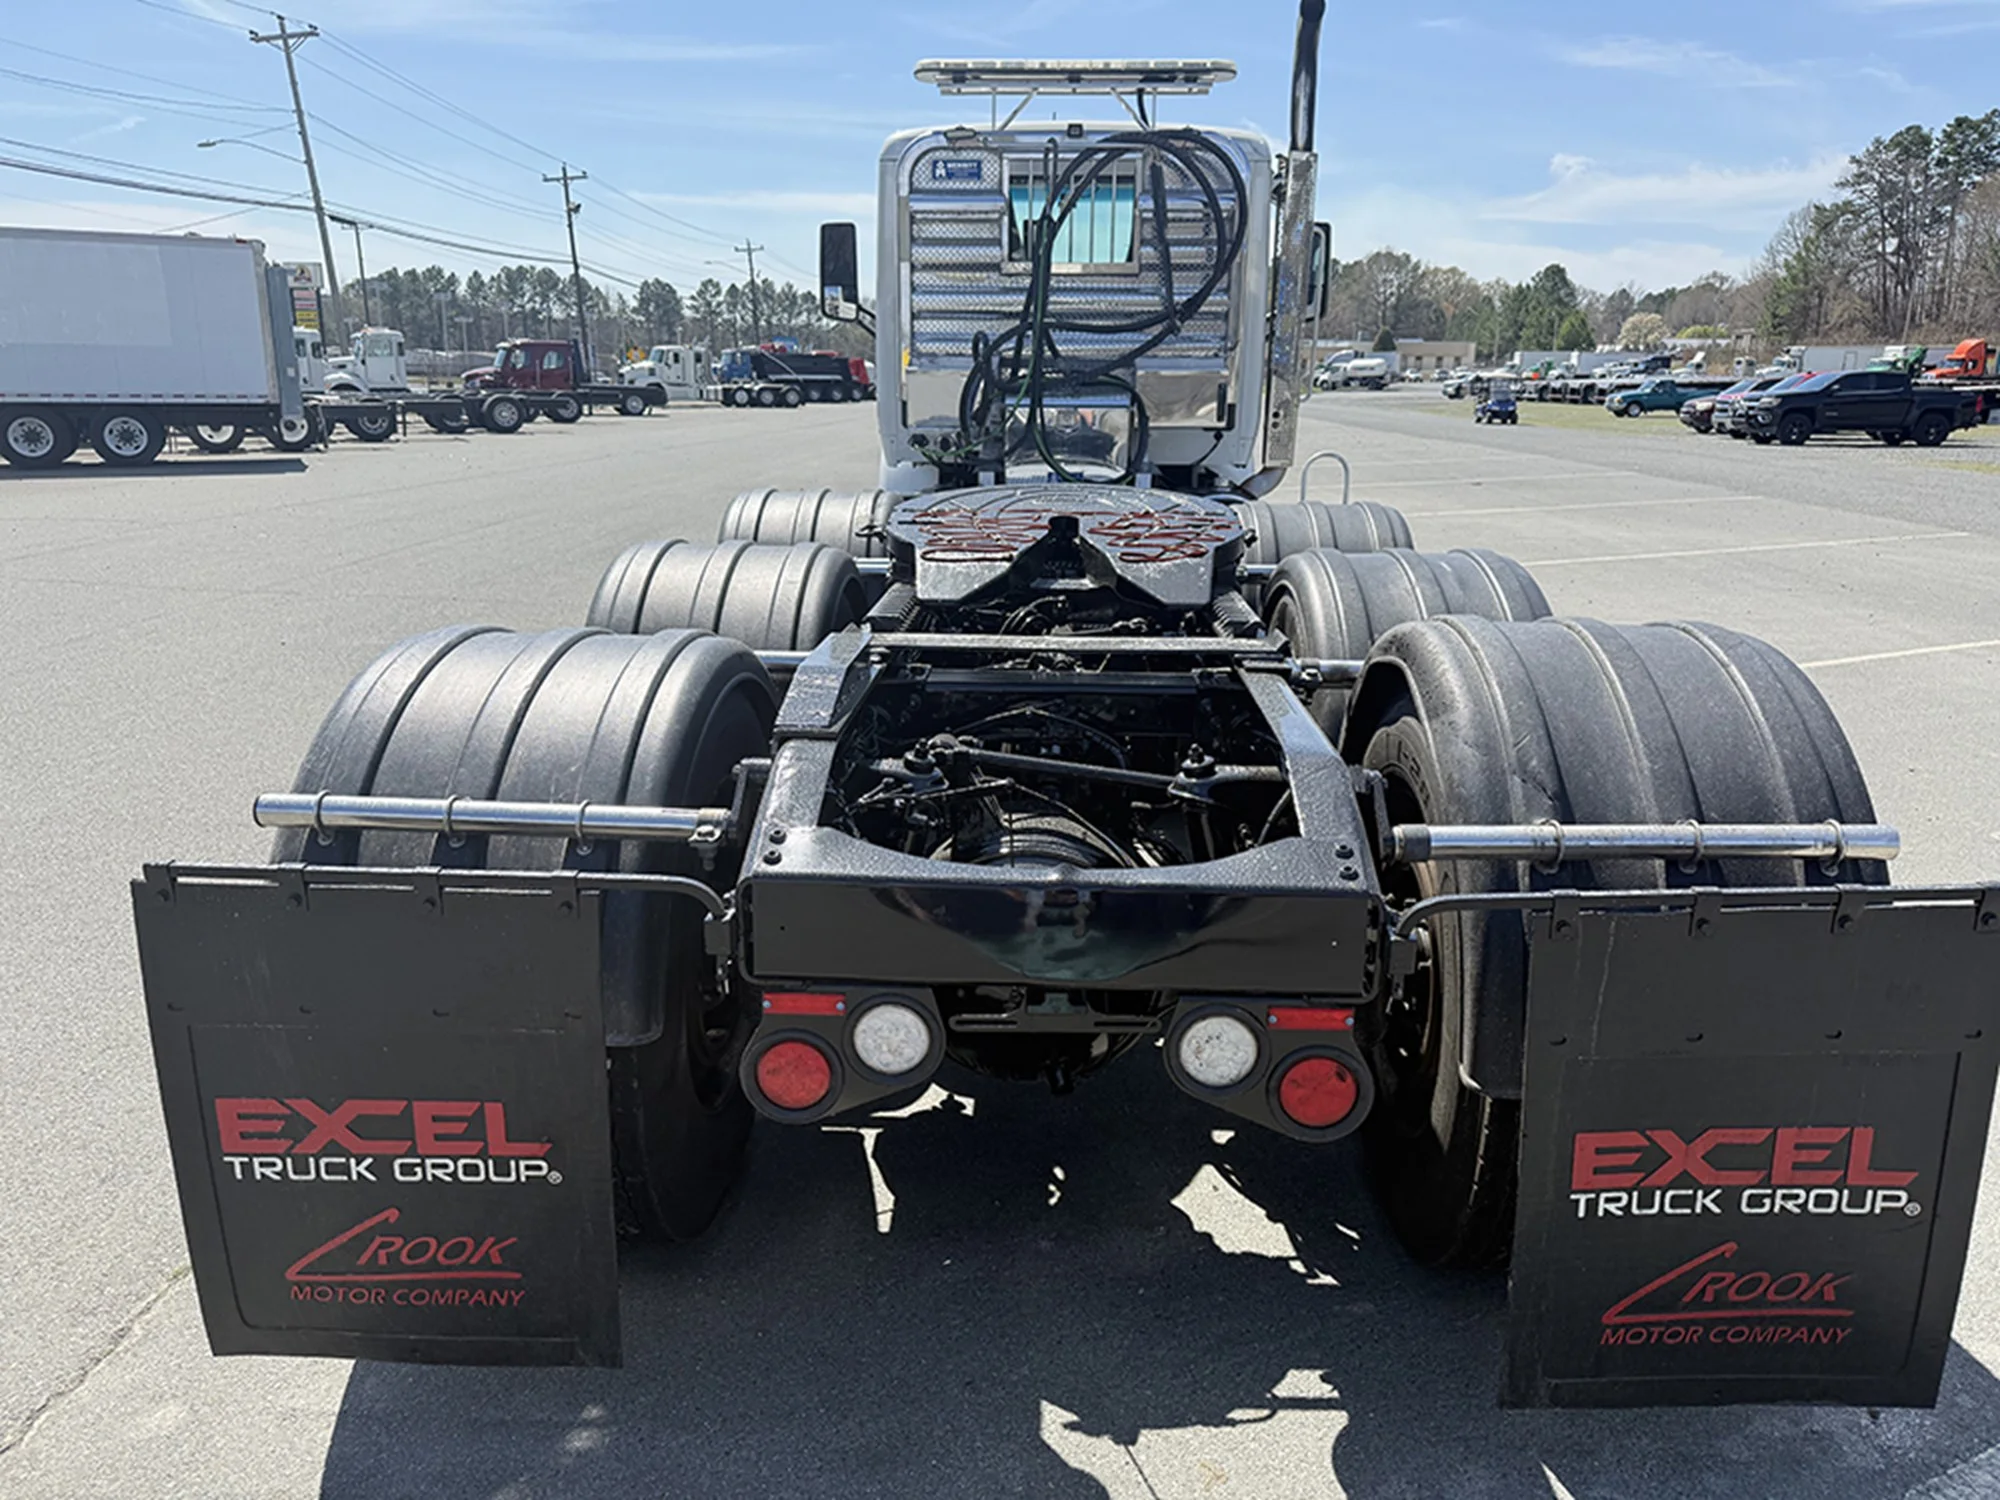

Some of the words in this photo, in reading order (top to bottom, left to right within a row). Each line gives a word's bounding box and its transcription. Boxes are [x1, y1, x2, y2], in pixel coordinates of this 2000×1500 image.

[215, 1098, 553, 1156] EXCEL
[223, 1156, 377, 1182] TRUCK
[1571, 1126, 1920, 1190] EXCEL
[1569, 1189, 1723, 1218] TRUCK
[290, 1285, 386, 1305] MOTOR
[393, 1287, 525, 1307] COMPANY
[1600, 1326, 1703, 1346] MOTOR
[1709, 1326, 1852, 1345] COMPANY
